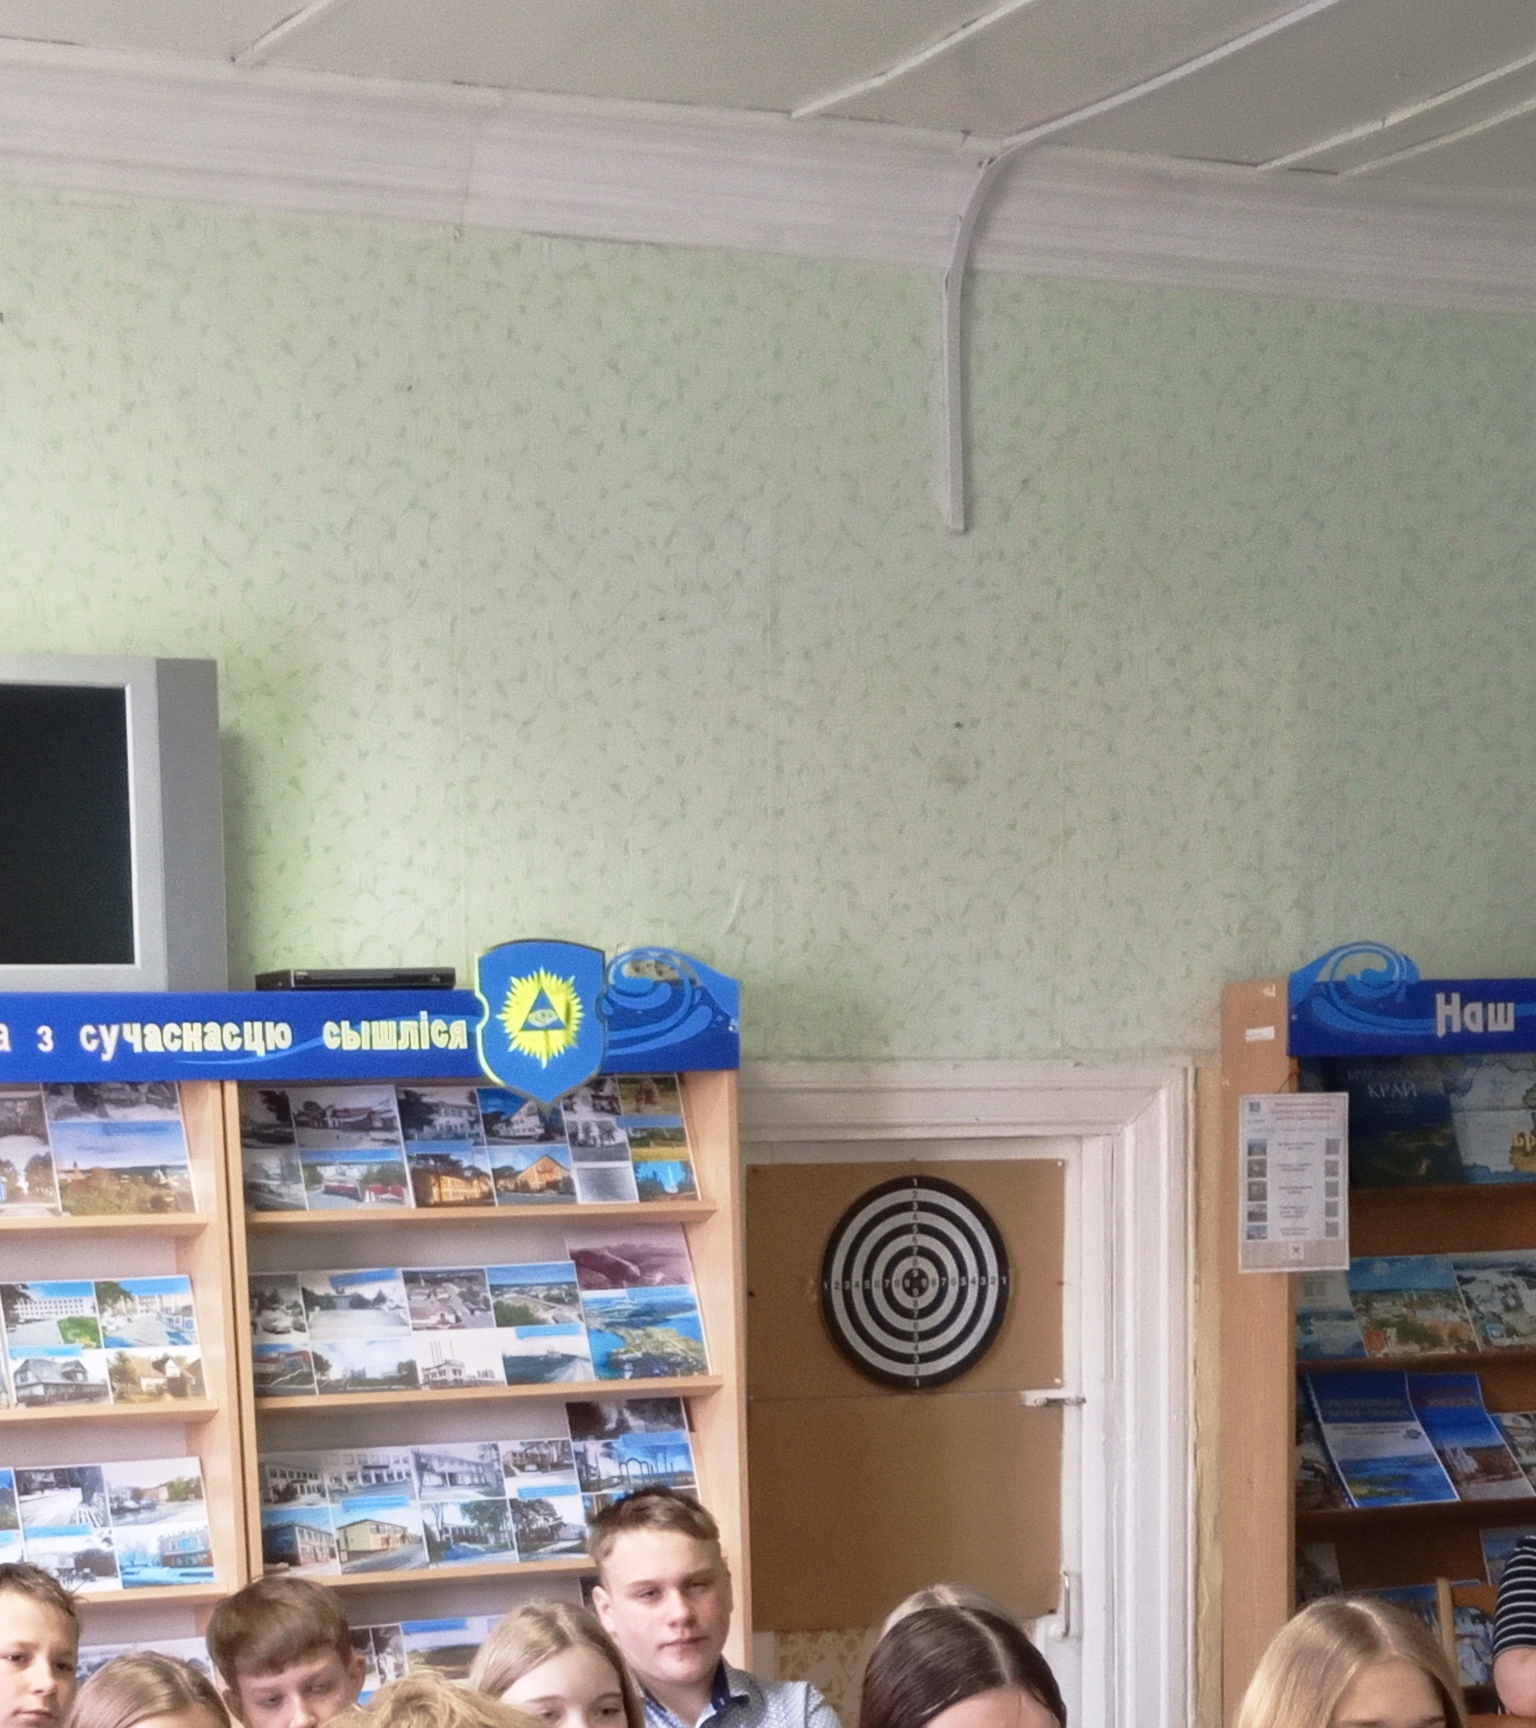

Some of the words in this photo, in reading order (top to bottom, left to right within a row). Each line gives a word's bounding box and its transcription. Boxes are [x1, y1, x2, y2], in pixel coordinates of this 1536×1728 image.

[36, 1024, 55, 1053] з
[80, 1020, 292, 1062] сучаснасцю
[322, 1010, 468, 1050] сышліся
[1435, 991, 1515, 1039] Наш
